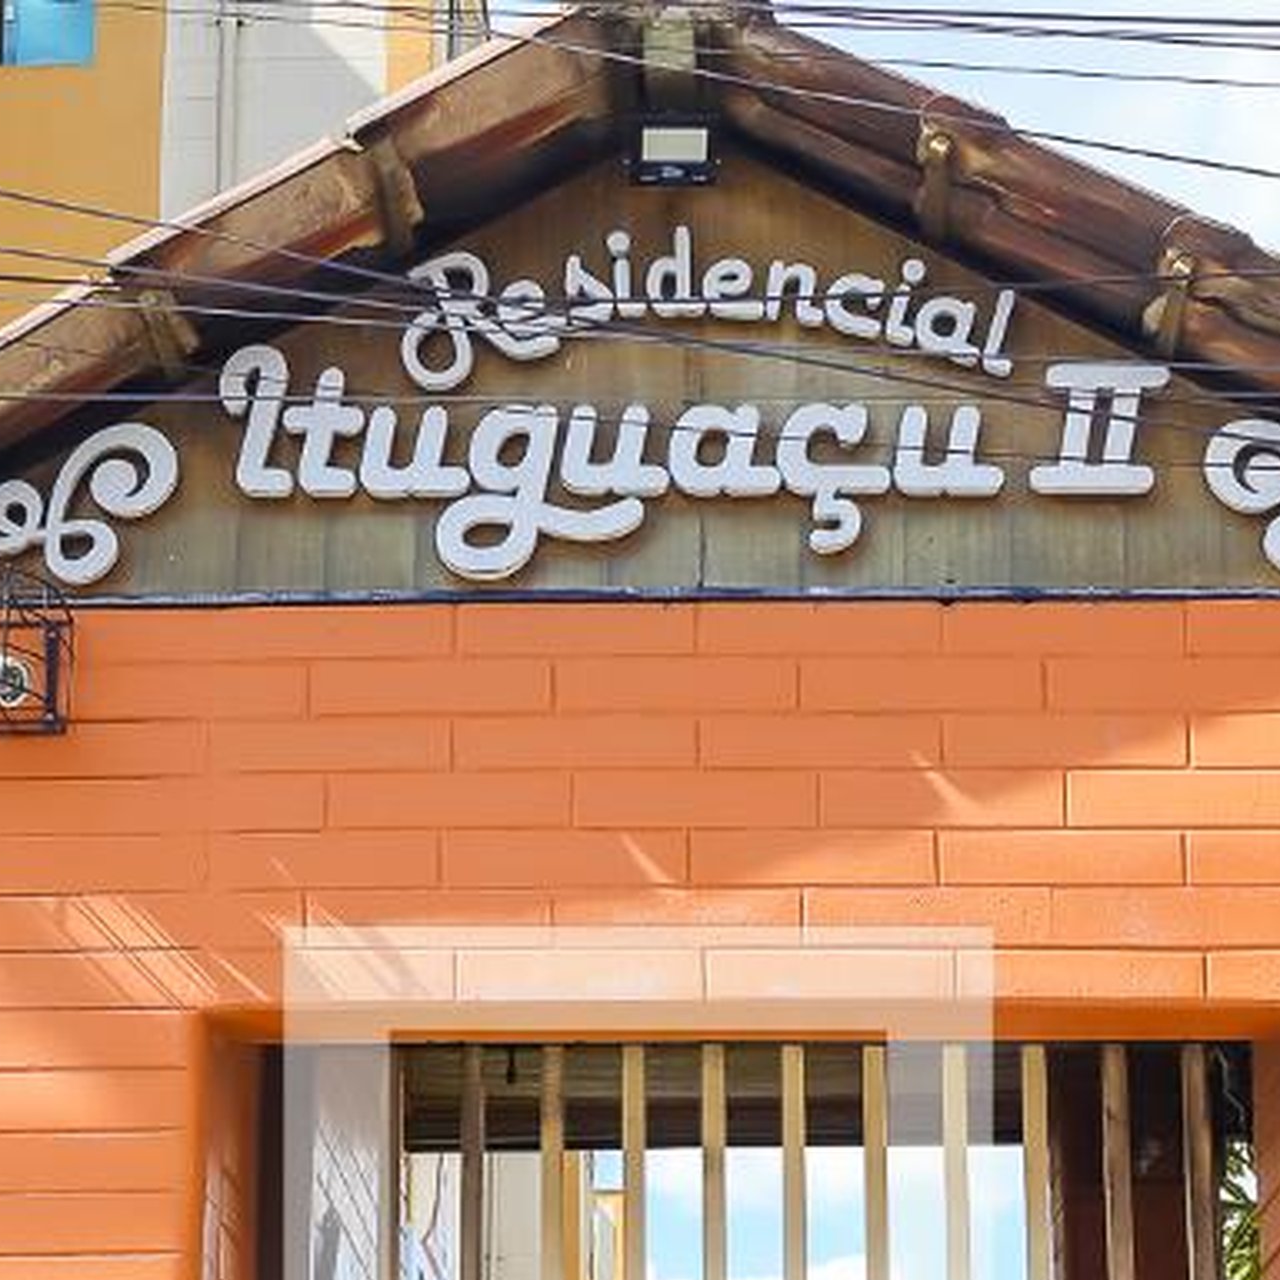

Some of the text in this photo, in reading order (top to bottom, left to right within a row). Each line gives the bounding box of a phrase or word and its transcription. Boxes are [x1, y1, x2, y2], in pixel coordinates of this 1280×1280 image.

[400, 226, 1016, 390] Residencial
[219, 345, 1170, 580] Ituguaçu II
